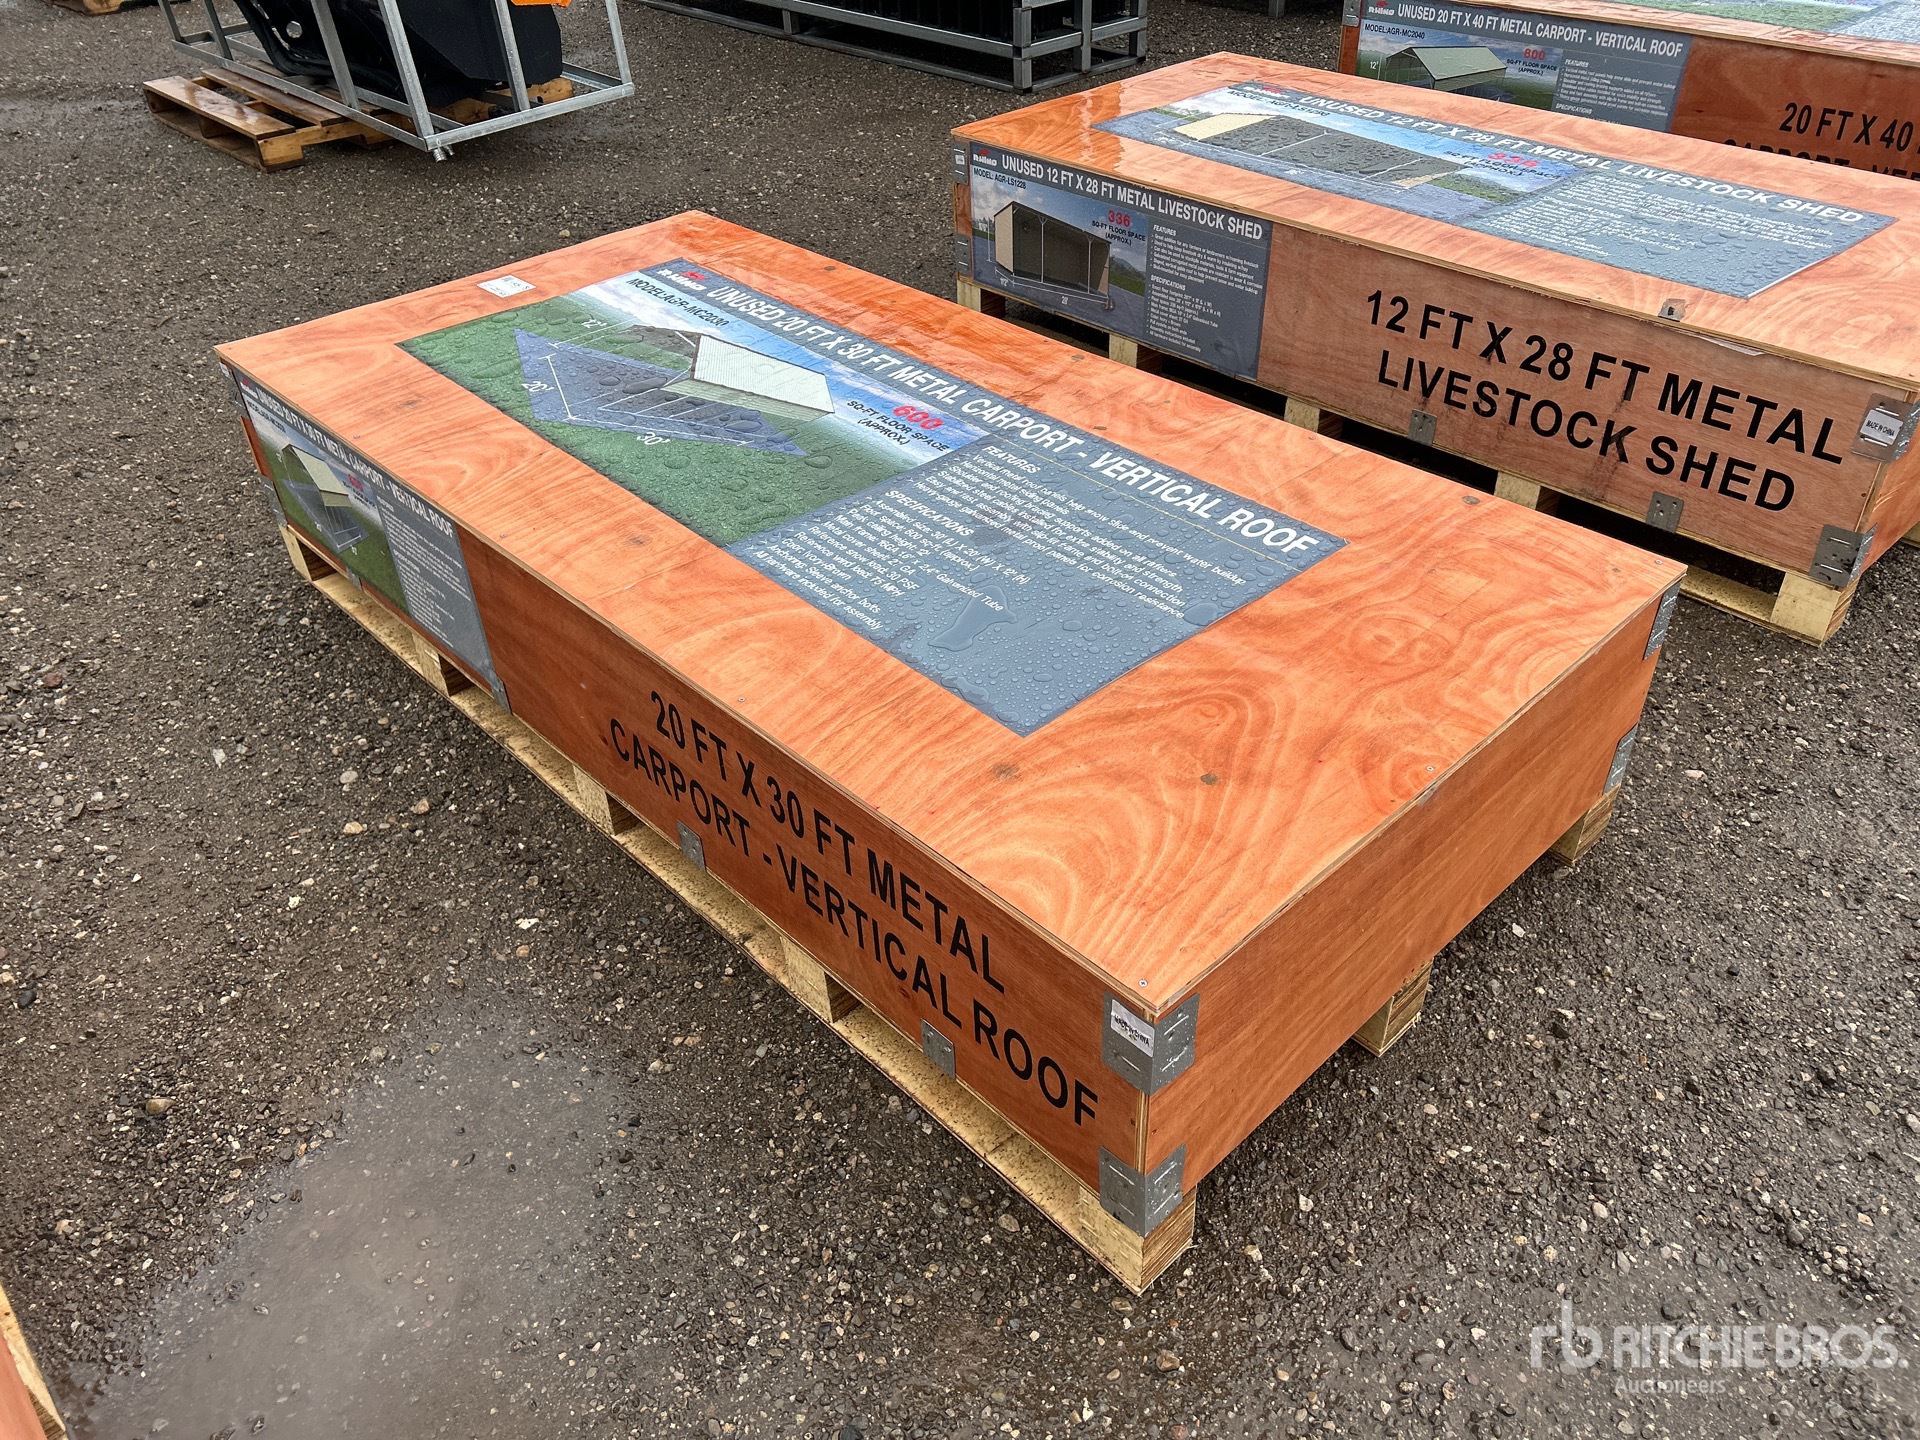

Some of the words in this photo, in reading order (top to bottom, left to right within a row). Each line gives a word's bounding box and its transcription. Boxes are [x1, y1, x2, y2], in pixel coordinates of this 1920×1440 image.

[1397, 3, 1435, 20] UNUSED
[1436, 9, 1448, 23] 20
[1449, 10, 1463, 25] FT
[1463, 12, 1471, 26] X
[1472, 14, 1484, 28] 40
[1485, 15, 1498, 30] FT
[1499, 17, 1532, 35] METAL
[1535, 23, 1586, 42] CARPORT
[1595, 31, 1646, 52] VERTICAL
[1649, 39, 1683, 57] ROOF
[1524, 48, 1545, 60] 800
[1779, 102, 1812, 134] 20
[1815, 108, 1854, 140] FT
[1853, 114, 1878, 145] X
[1880, 119, 1914, 152] 40
[1299, 96, 1384, 118] UNUSED
[1411, 120, 1446, 131] FT
[1440, 127, 1466, 136] X
[1461, 132, 1495, 142] 28
[1492, 138, 1531, 149] FT
[1527, 145, 1610, 169] METAL
[1617, 165, 1775, 203] LIVESTOCK
[1777, 198, 1863, 222] SHED
[1002, 154, 1043, 178] UNUSED
[1047, 167, 1058, 183] 12
[1061, 171, 1073, 187] FT
[1075, 175, 1083, 190] X
[1086, 177, 1098, 194] 28
[1101, 181, 1114, 198] FT
[1117, 185, 1154, 210] METAL
[1158, 197, 1224, 229] LIVESTOCK
[1227, 216, 1262, 239] SHED
[1108, 209, 1130, 227] 336
[520, 380, 554, 392] 20'
[1367, 290, 1410, 334] 12
[1419, 304, 1473, 349] FT
[1479, 320, 1514, 364] X
[1519, 334, 1574, 381] 28
[1585, 352, 1650, 401] FT
[1658, 373, 1843, 465] METAL
[636, 431, 670, 445] 30'
[707, 286, 785, 320] UNUSED
[771, 316, 809, 331] 20
[794, 325, 835, 341] FT
[818, 335, 852, 350] X
[837, 343, 873, 359] 30
[860, 353, 903, 371] FT
[888, 366, 965, 404] METAL
[962, 399, 1083, 451] CARPORT
[1090, 452, 1220, 517] VERTICAL
[1218, 508, 1318, 552] ROOF
[846, 400, 878, 416] SQ-FT
[876, 414, 912, 434] FLOOR
[910, 432, 950, 451] SPACE
[893, 405, 942, 429] 600
[1378, 349, 1638, 464] LIVESTOCK
[1645, 436, 1795, 512] SHED
[1866, 420, 1879, 430] MADE
[1883, 426, 1895, 436] CHINA
[982, 445, 1040, 473] FEATURES
[885, 490, 973, 535] SPECIFICATIONS
[937, 470, 976, 490] Stabilized
[971, 489, 996, 500] steel
[991, 498, 1019, 513] cables
[1017, 510, 1054, 529] installed
[1050, 526, 1067, 536] for
[1065, 534, 1090, 547] extra
[1088, 546, 1125, 565] stability
[1123, 563, 1145, 573] and
[1142, 570, 1182, 593] strength
[807, 526, 847, 550] Reference
[845, 549, 868, 562] snow
[885, 571, 901, 580] 30
[896, 577, 919, 589] PSF
[752, 550, 769, 558] All
[762, 555, 800, 579] hardware
[797, 578, 834, 599] included
[828, 596, 846, 606] for
[843, 605, 883, 629] assembly
[651, 691, 683, 749] 20
[690, 718, 728, 780] FT
[736, 750, 761, 808] X
[767, 776, 805, 839] 30
[814, 809, 855, 876] FT
[867, 849, 1006, 994] METAL
[610, 718, 750, 857] CARPORT
[974, 1012, 1098, 1126] ROOF
